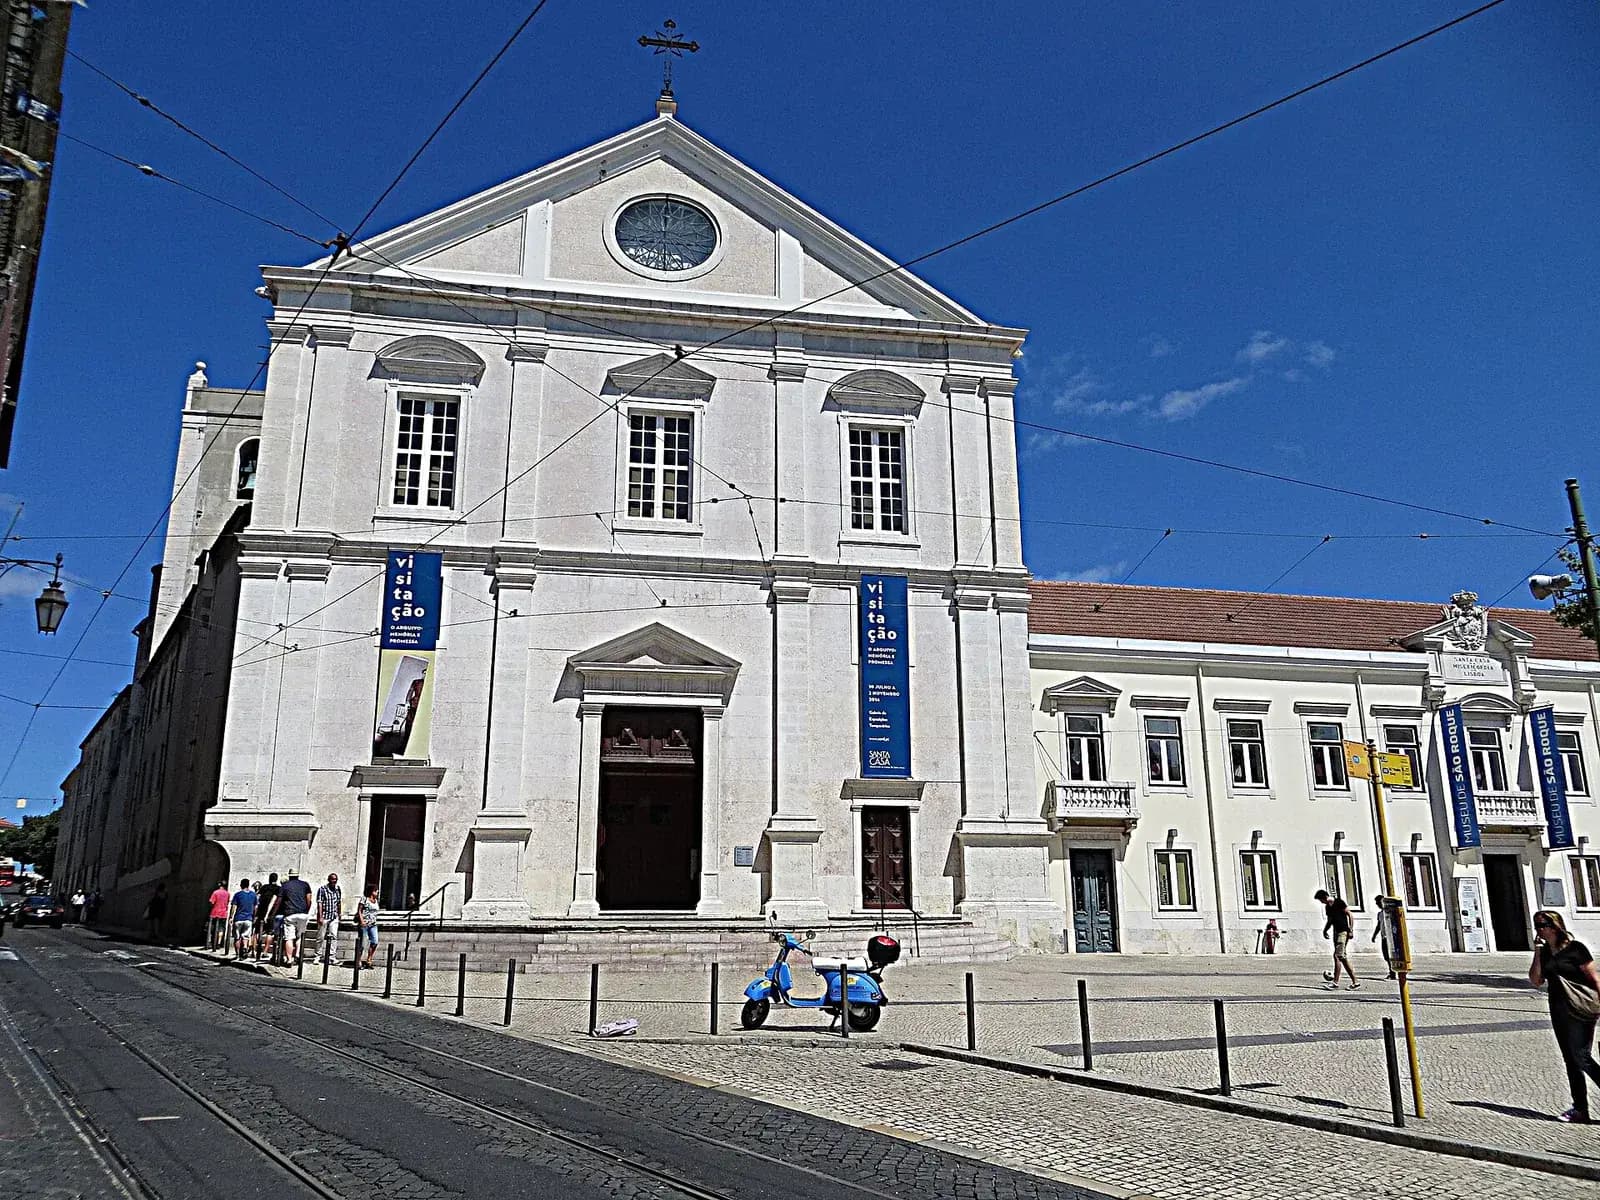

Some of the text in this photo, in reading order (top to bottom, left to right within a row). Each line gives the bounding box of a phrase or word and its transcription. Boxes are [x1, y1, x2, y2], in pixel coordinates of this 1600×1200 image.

[395, 554, 414, 569] vi
[395, 571, 412, 585] si
[867, 580, 883, 593] vi
[392, 587, 413, 600] ta
[868, 596, 883, 609] si
[391, 603, 425, 622] ção
[866, 611, 885, 624] ta
[867, 626, 897, 643] ção
[868, 750, 890, 758] SANTA
[869, 757, 890, 766] CASA
[1445, 709, 1473, 843] MUSEU DE SÃO ROQUE
[1536, 712, 1567, 844] MUSEU DE SÃO ROQUE
